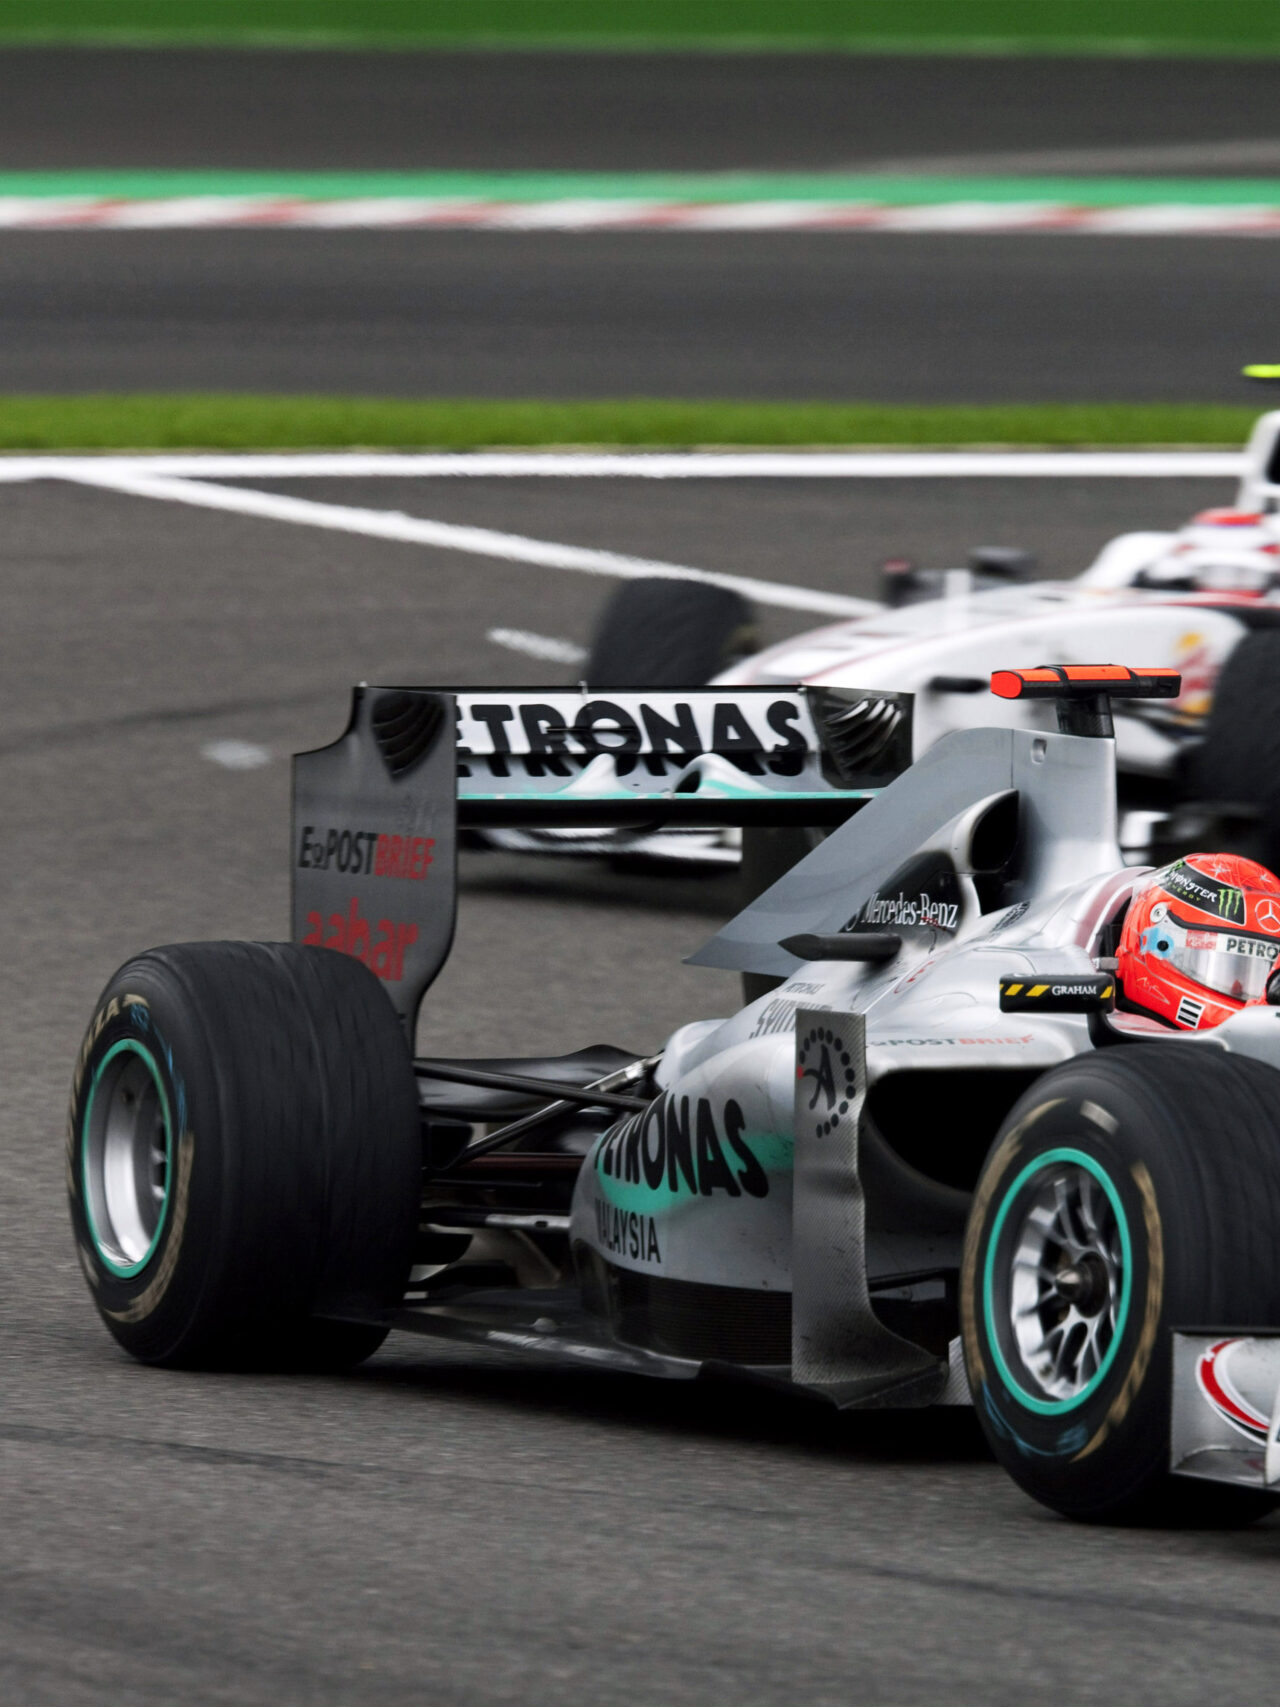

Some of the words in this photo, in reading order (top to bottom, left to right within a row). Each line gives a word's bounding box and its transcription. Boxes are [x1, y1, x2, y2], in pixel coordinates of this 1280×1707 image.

[456, 700, 808, 776] TRONAS
[1169, 870, 1218, 903] MONSTER
[845, 891, 959, 931] Mercedes-Benz
[1051, 985, 1097, 996] GRAHAM
[594, 1085, 769, 1199] PETRONAS
